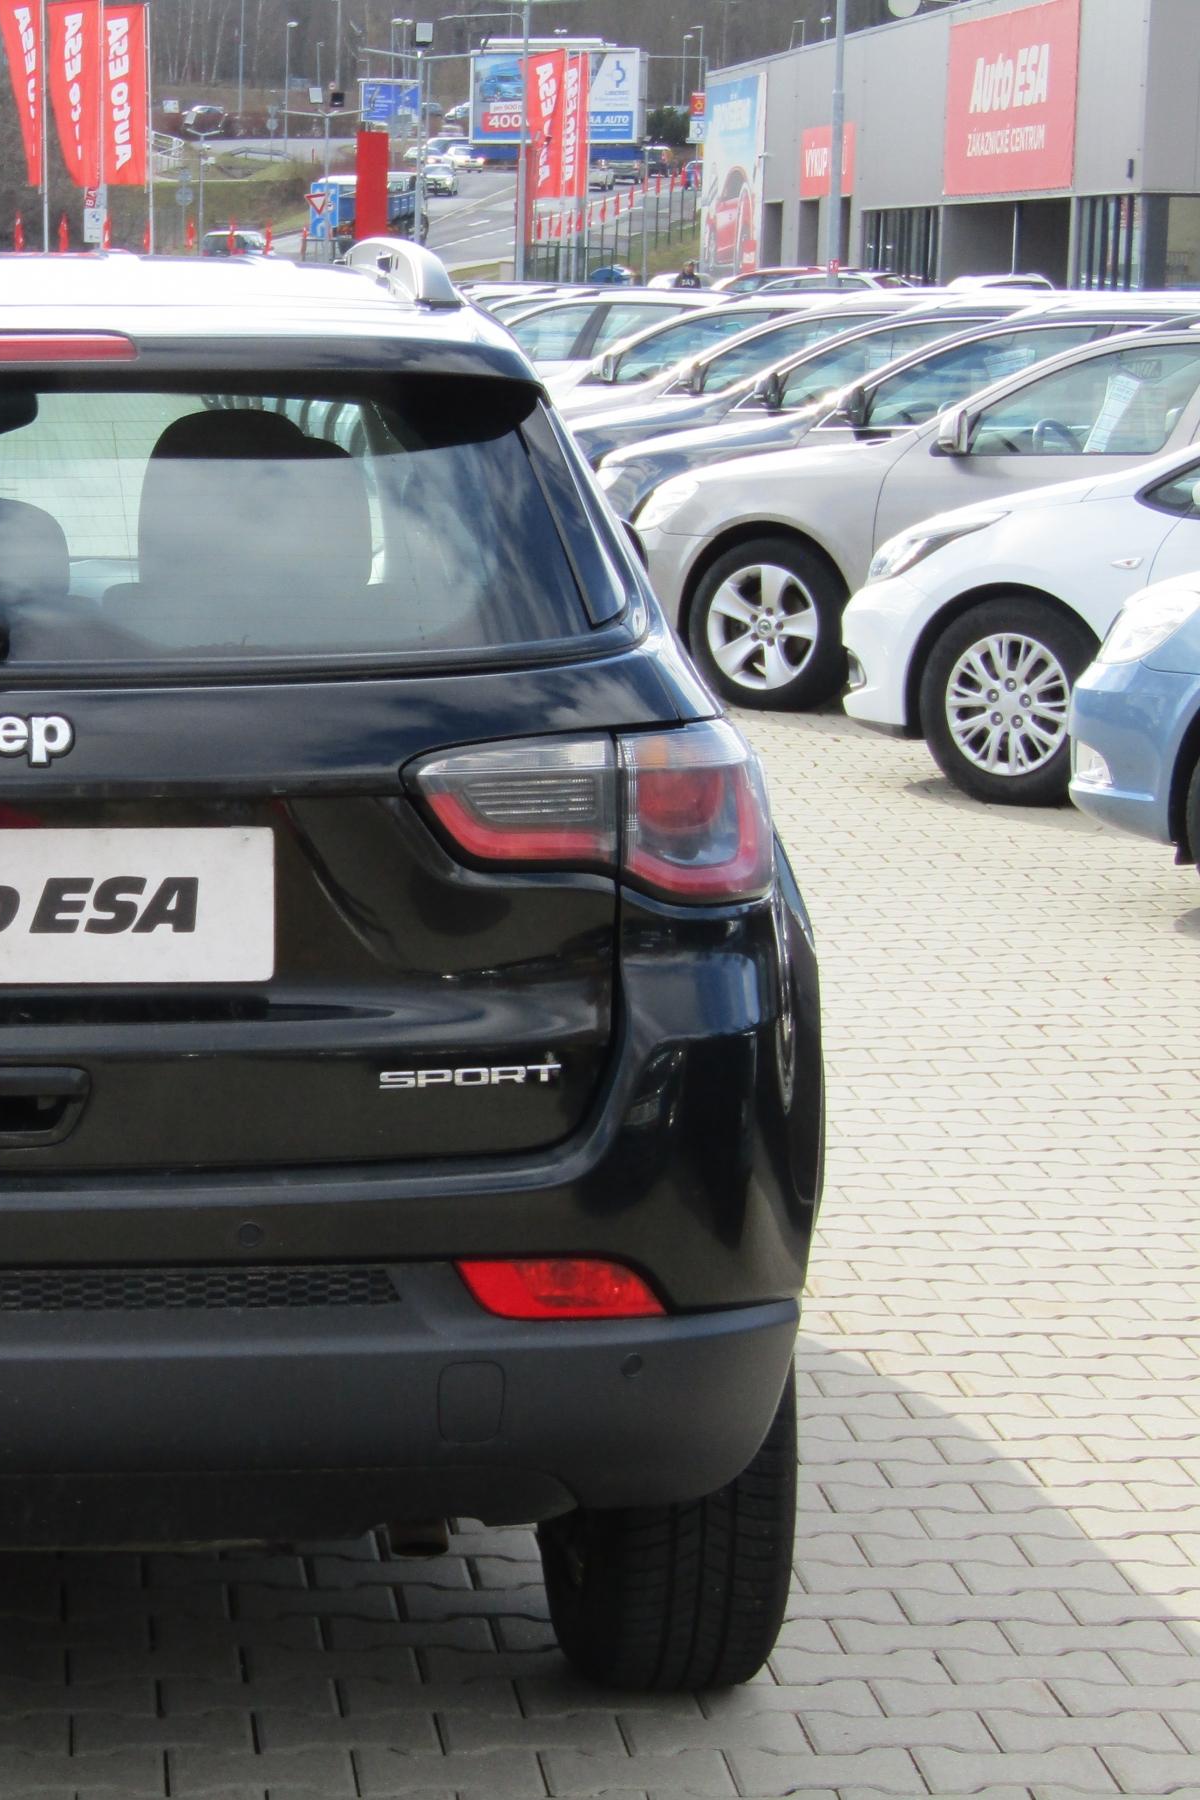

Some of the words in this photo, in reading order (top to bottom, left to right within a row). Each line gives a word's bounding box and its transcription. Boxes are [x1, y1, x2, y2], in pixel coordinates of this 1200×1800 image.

[969, 52, 1014, 114] Auto
[1013, 43, 1050, 108] ESA
[488, 114, 521, 128] 400
[604, 115, 630, 124] AUTO
[1010, 124, 1045, 153] CENTRUM
[805, 142, 828, 178] VÝKUP
[29, 875, 199, 934] ESA
[379, 1064, 562, 1089] SPORT
